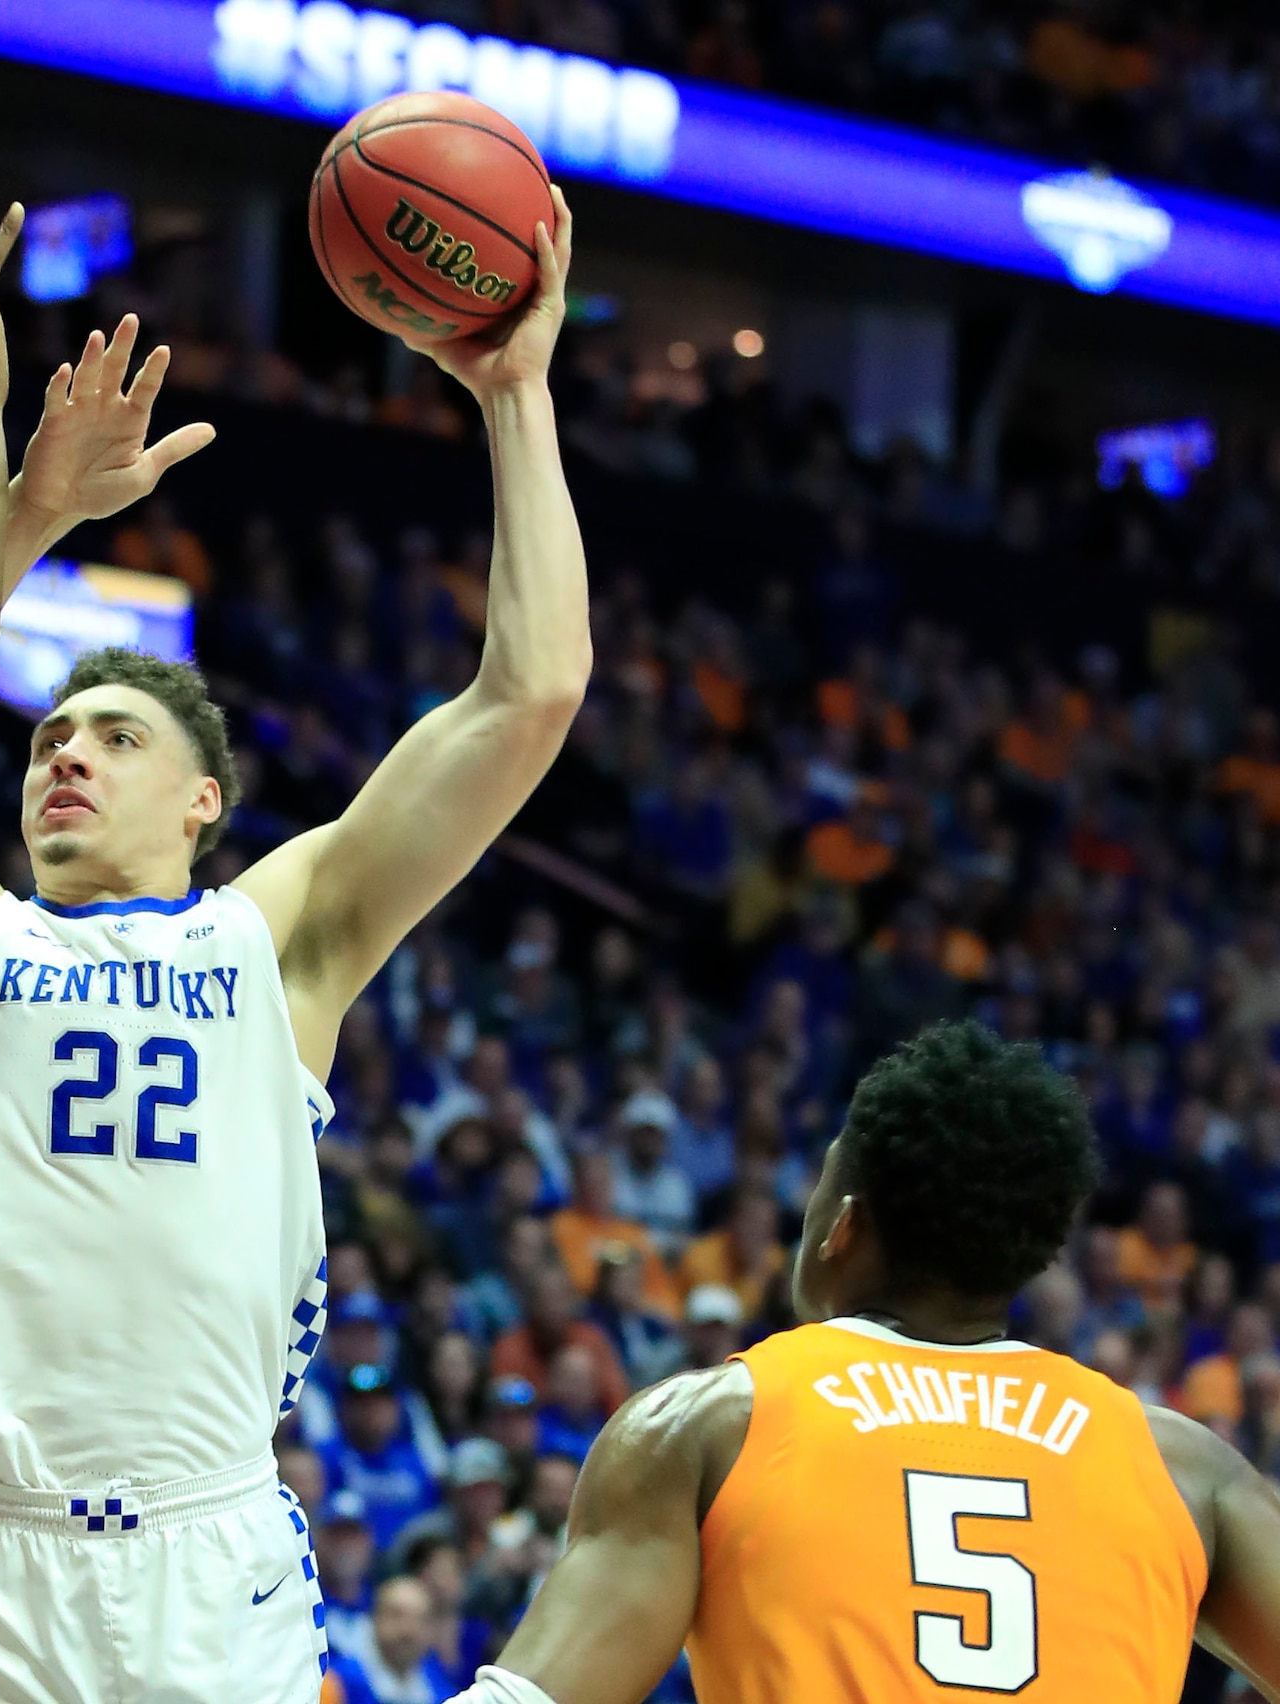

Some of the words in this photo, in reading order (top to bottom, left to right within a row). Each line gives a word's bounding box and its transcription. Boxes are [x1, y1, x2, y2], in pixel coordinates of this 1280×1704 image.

[384, 197, 518, 304] Wilson
[47, 1029, 200, 1167] 22
[813, 1362, 1090, 1455] SCHOFIELD
[903, 1469, 1039, 1695] 5
